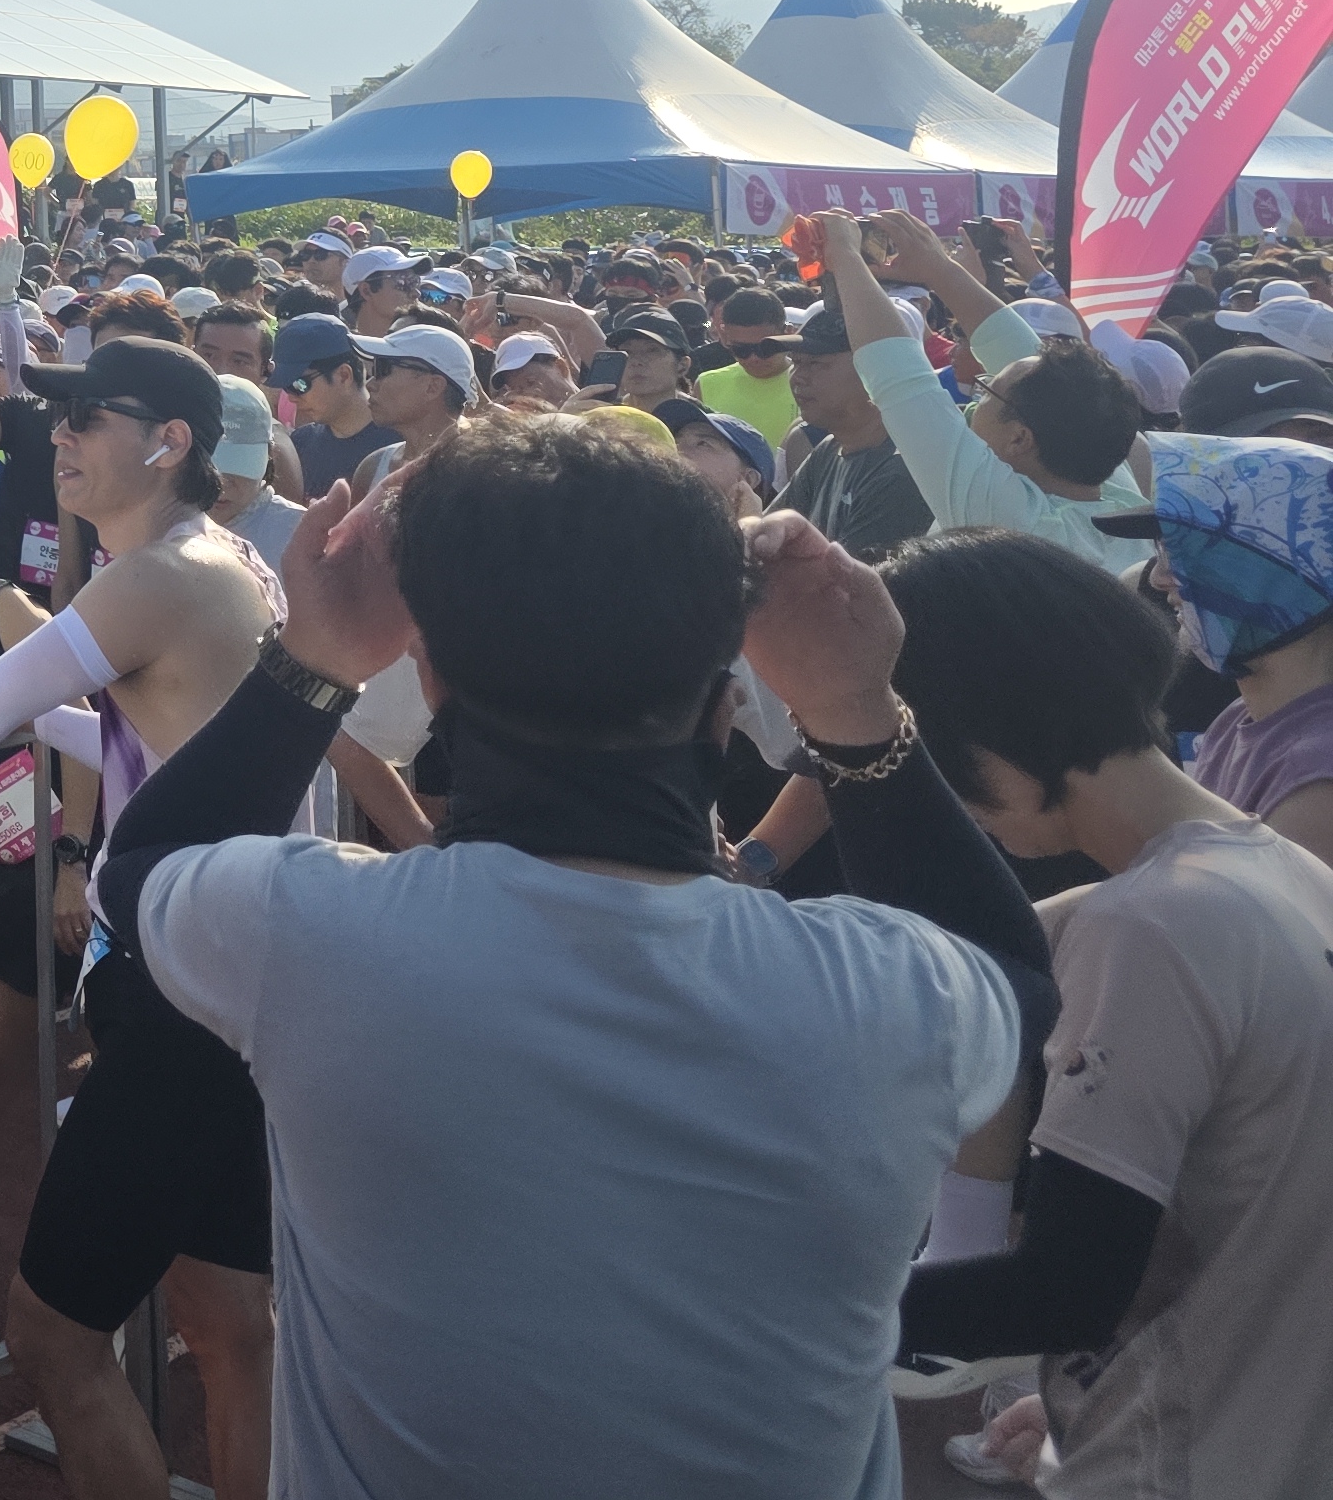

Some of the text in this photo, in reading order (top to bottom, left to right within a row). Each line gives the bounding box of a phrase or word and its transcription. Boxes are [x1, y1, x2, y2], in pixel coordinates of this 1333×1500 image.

[1133, 25, 1168, 67] 마라톤
[1160, 1, 1188, 32] 전문
[1128, 44, 1231, 187] WORLD
